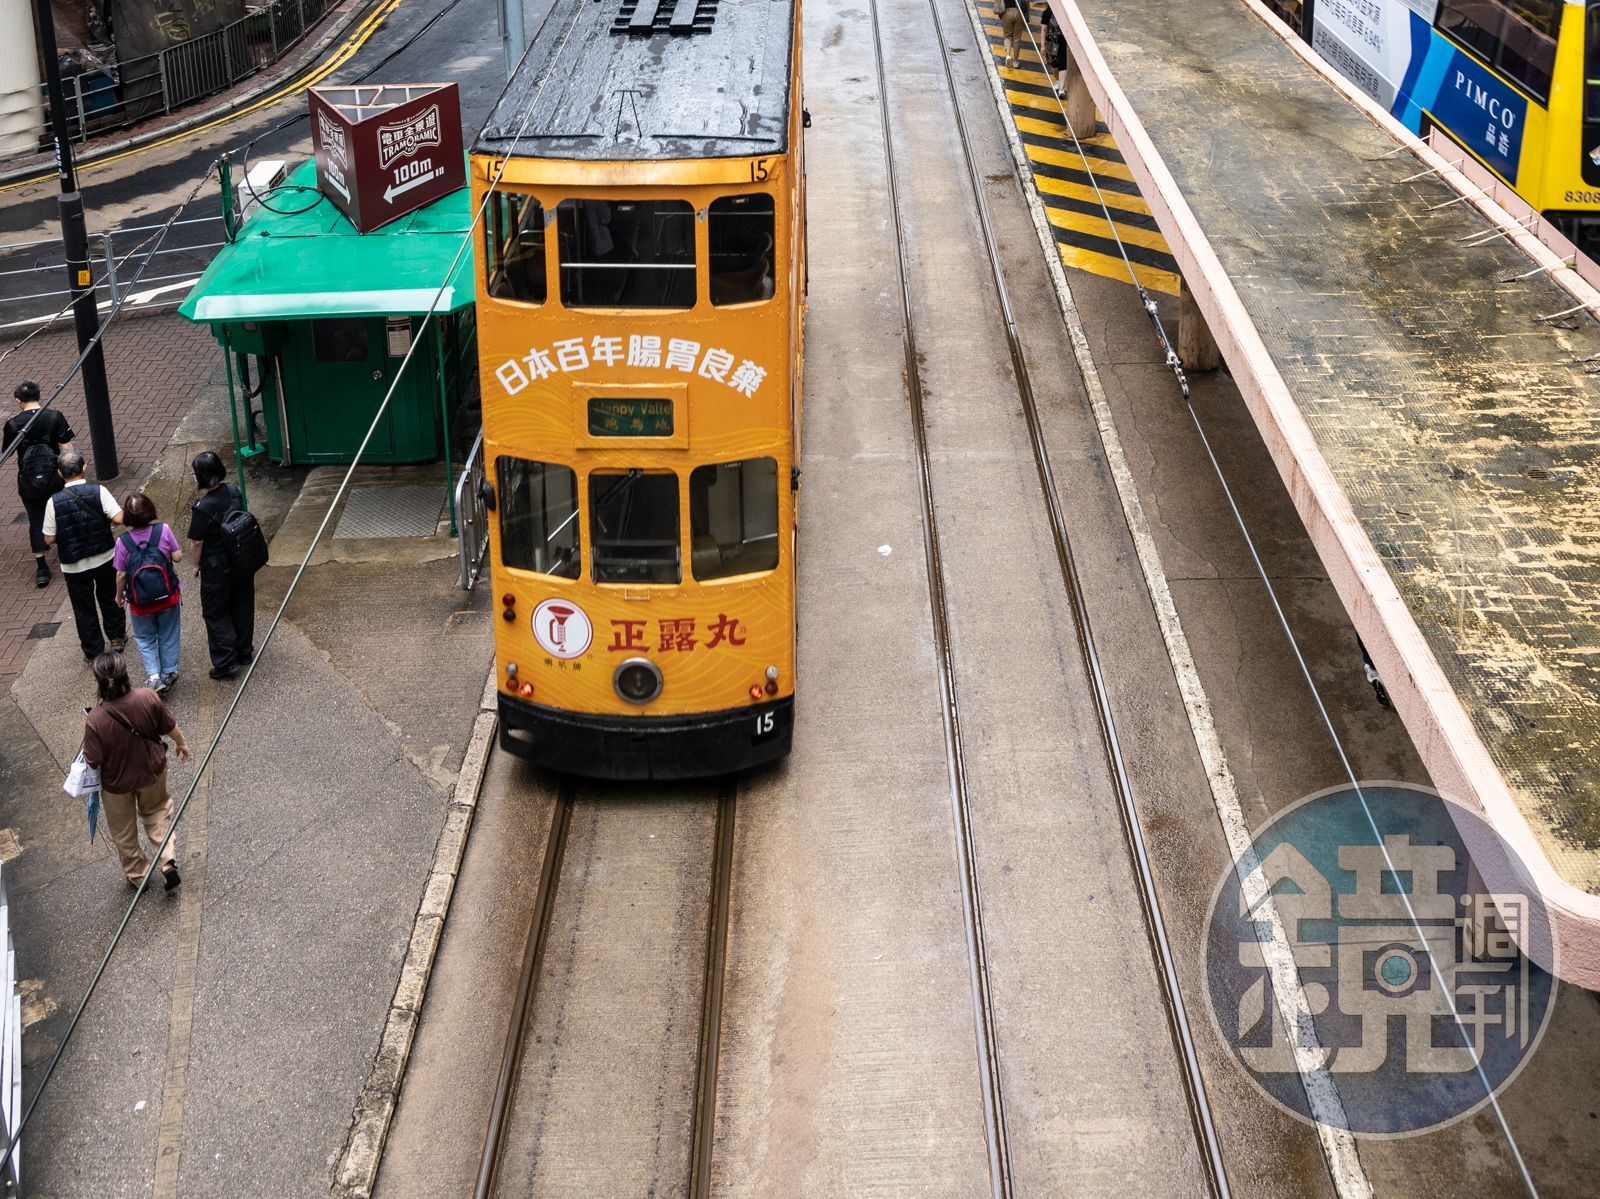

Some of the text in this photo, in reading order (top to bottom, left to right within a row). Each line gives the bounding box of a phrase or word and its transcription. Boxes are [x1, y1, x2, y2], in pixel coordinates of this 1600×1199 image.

[1454, 70, 1515, 129] PIMCO
[381, 112, 437, 145] 電車全景遊
[382, 127, 438, 161] TRAMORAMIC
[393, 158, 432, 185] 100m
[487, 161, 503, 181] 15
[751, 160, 768, 182] 15
[495, 334, 768, 399] 日本百年腸胃良藥
[607, 613, 747, 654] 正露丸
[756, 711, 774, 736] 15
